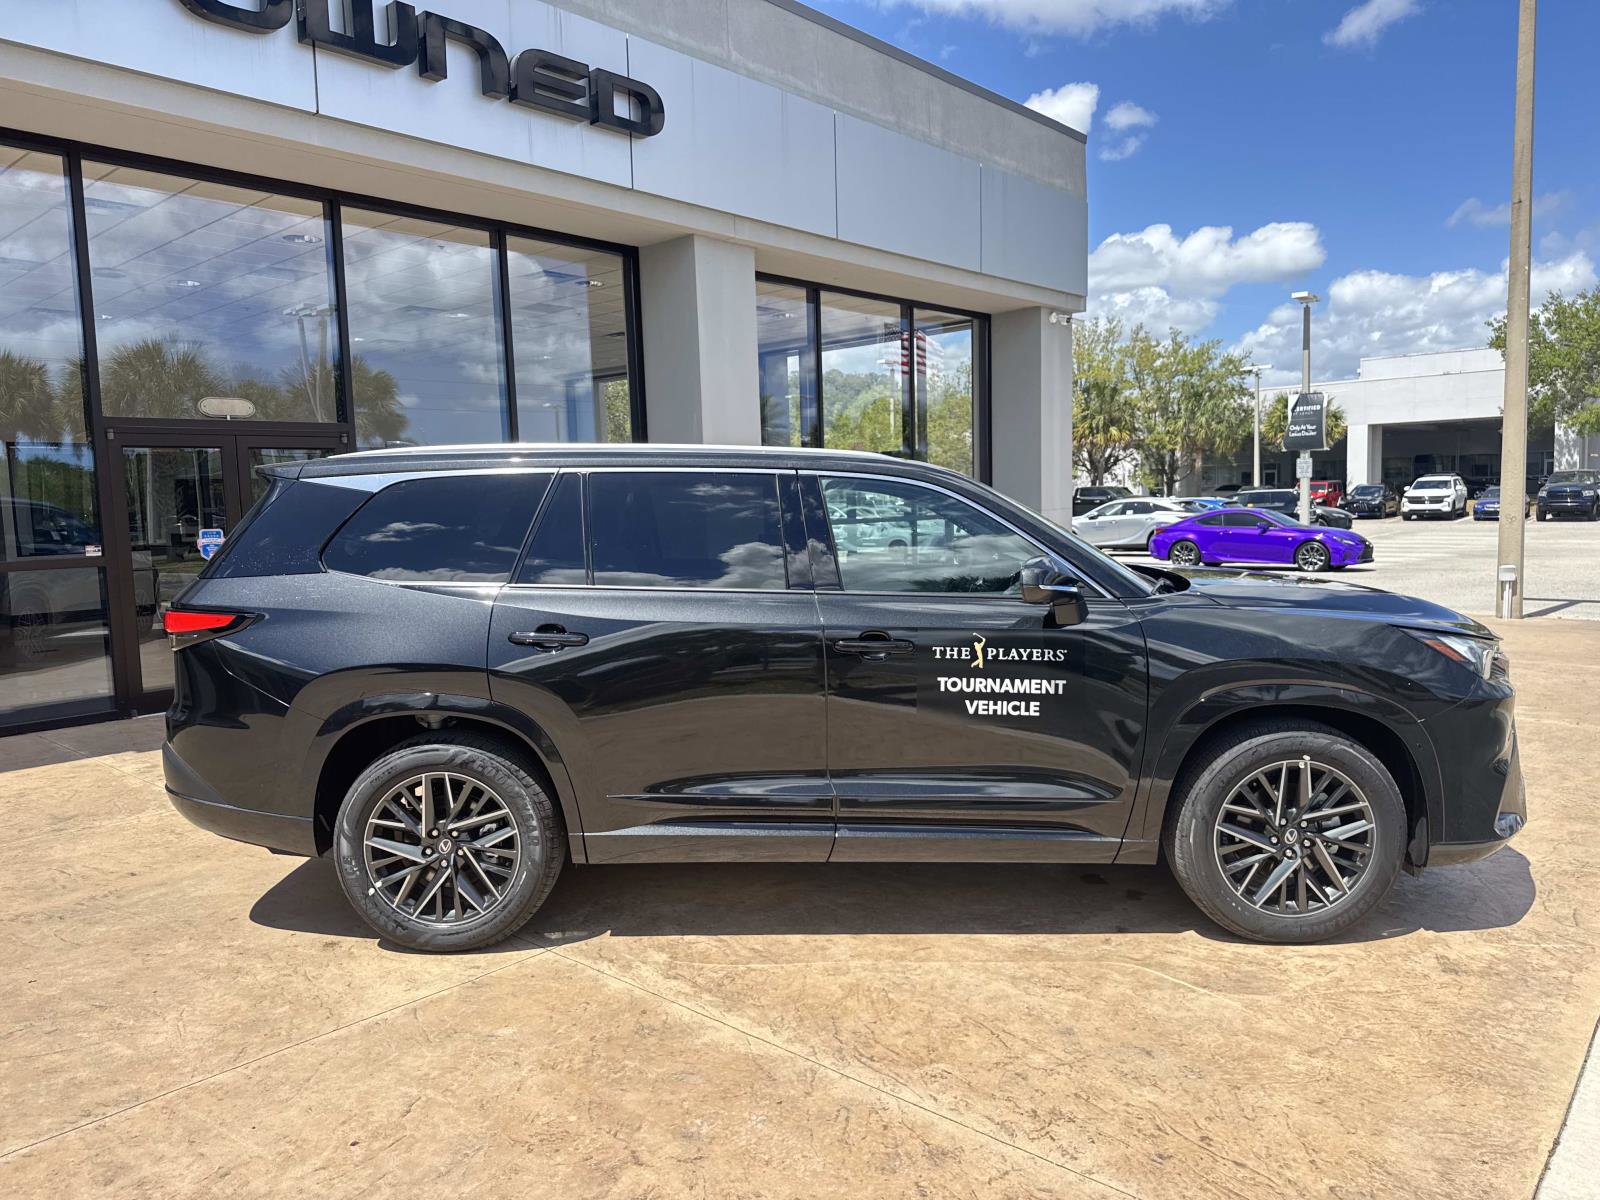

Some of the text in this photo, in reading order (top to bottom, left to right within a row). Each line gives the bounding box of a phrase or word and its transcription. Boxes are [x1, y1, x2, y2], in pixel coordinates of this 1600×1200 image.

[1294, 404, 1321, 412] ERTIFIED
[932, 646, 1066, 662] THE PLAYERS
[937, 677, 1067, 695] TOURNAMENT
[965, 699, 1040, 717] VEHICLE
